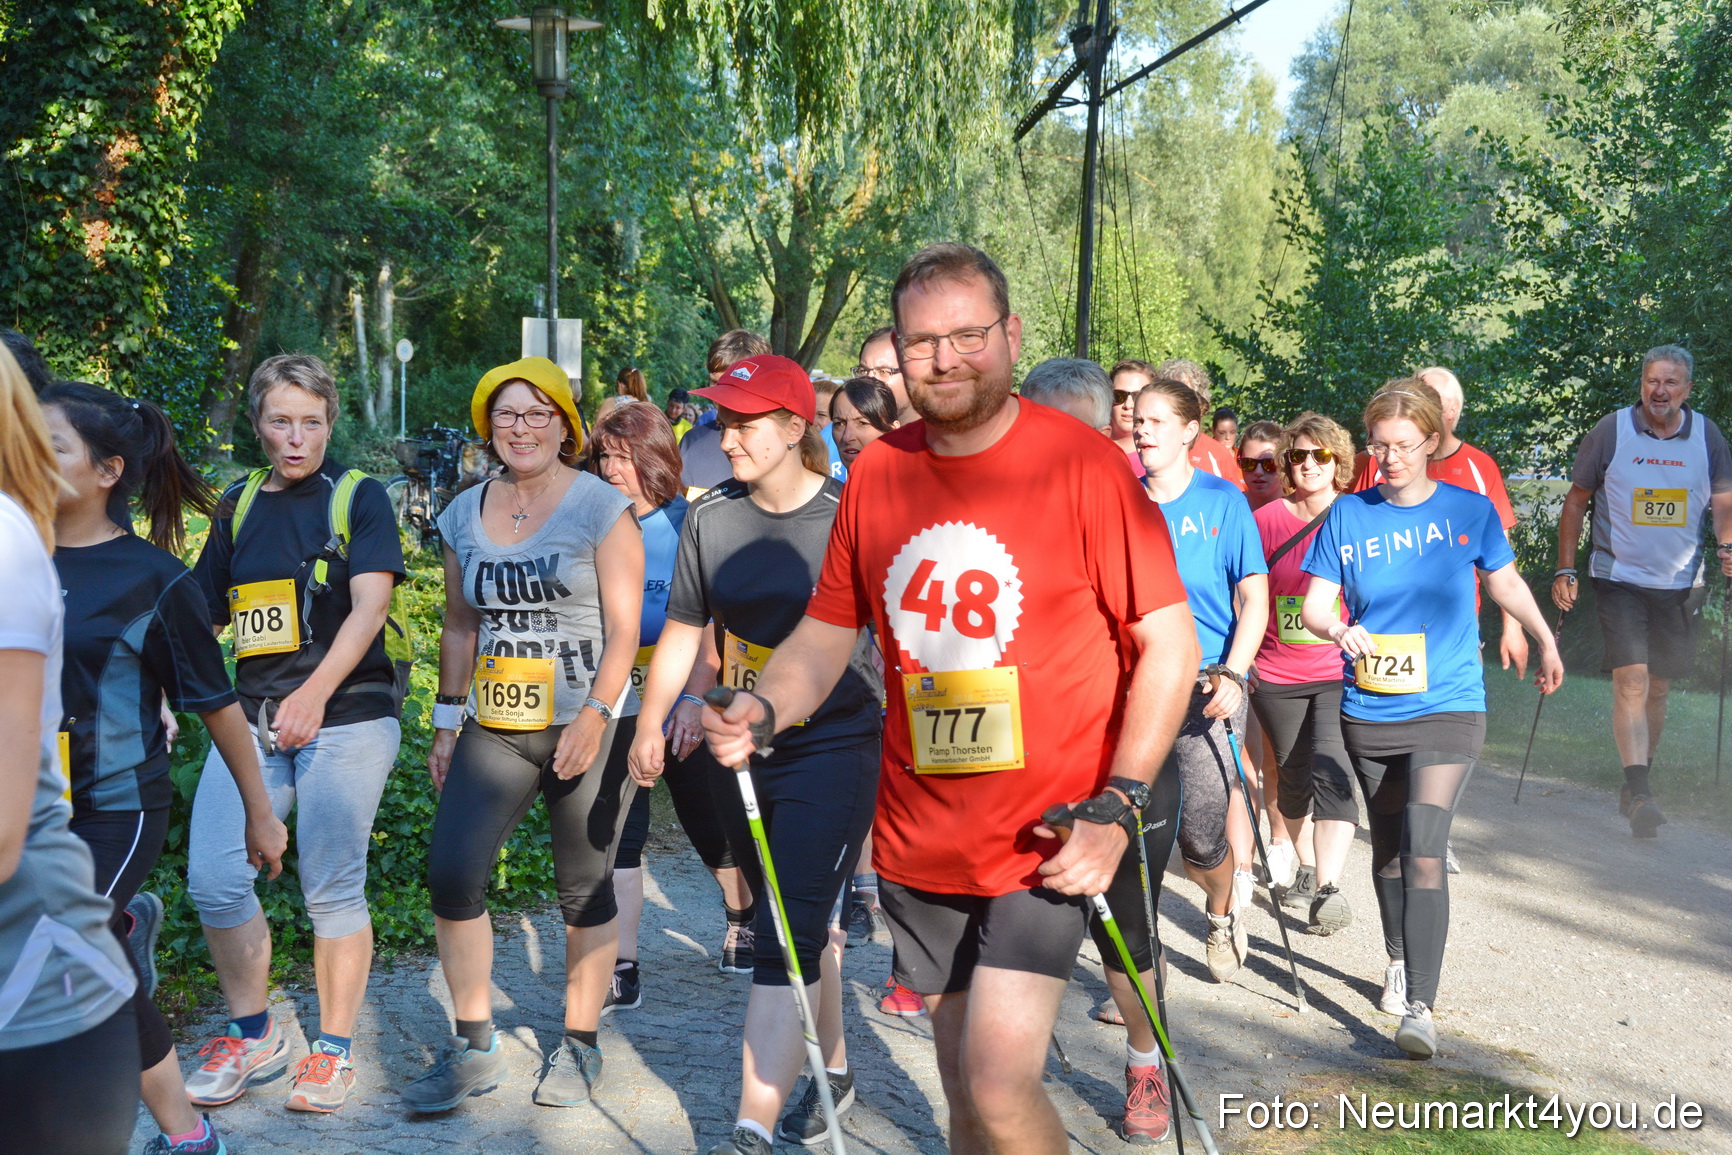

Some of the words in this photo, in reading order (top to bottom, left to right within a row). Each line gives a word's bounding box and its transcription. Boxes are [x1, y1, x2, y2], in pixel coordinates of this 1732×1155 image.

[1646, 458, 1686, 467] KLEBL
[711, 487, 728, 497] JAKO
[1644, 502, 1675, 516] 870
[234, 606, 283, 638] 1708
[1360, 654, 1415, 676] 1724
[482, 681, 541, 710] 1695
[505, 709, 525, 719] Sonja
[926, 707, 986, 745] 777
[929, 747, 950, 756] Plamp
[952, 745, 993, 755] Thorsten
